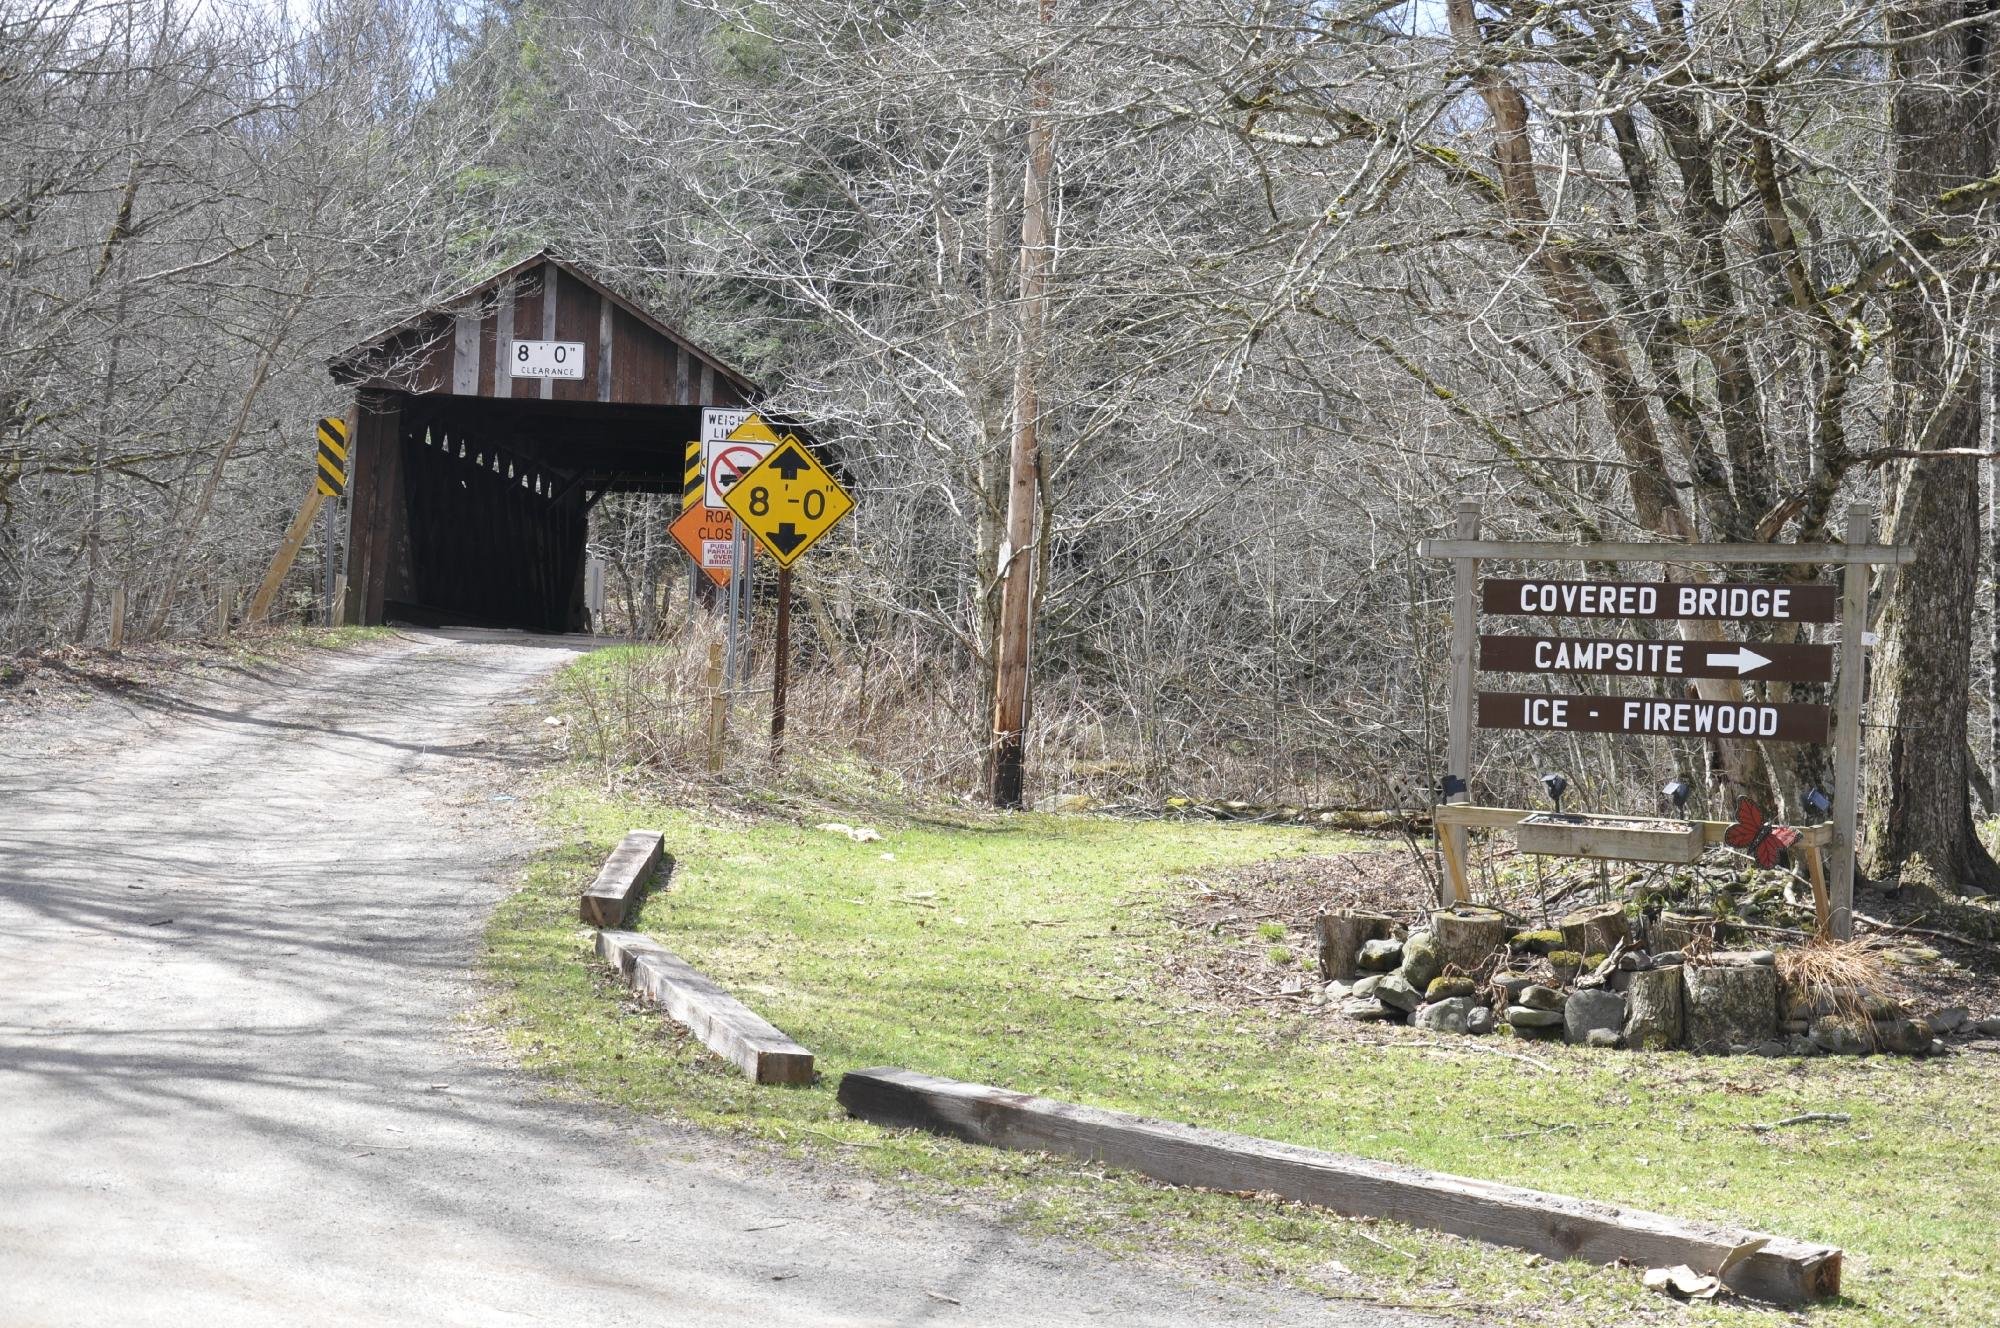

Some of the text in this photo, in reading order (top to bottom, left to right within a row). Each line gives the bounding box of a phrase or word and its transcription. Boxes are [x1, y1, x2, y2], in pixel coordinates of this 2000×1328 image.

[521, 367, 574, 376] CLEARANCE
[709, 414, 744, 426] WEIGH
[705, 510, 733, 523] ROA
[1520, 584, 1791, 618] COVERED BRIDGE
[1534, 641, 1684, 673] CAMPSITE
[1523, 698, 1568, 727] ICE
[1623, 701, 1778, 736] FIREWOOD
